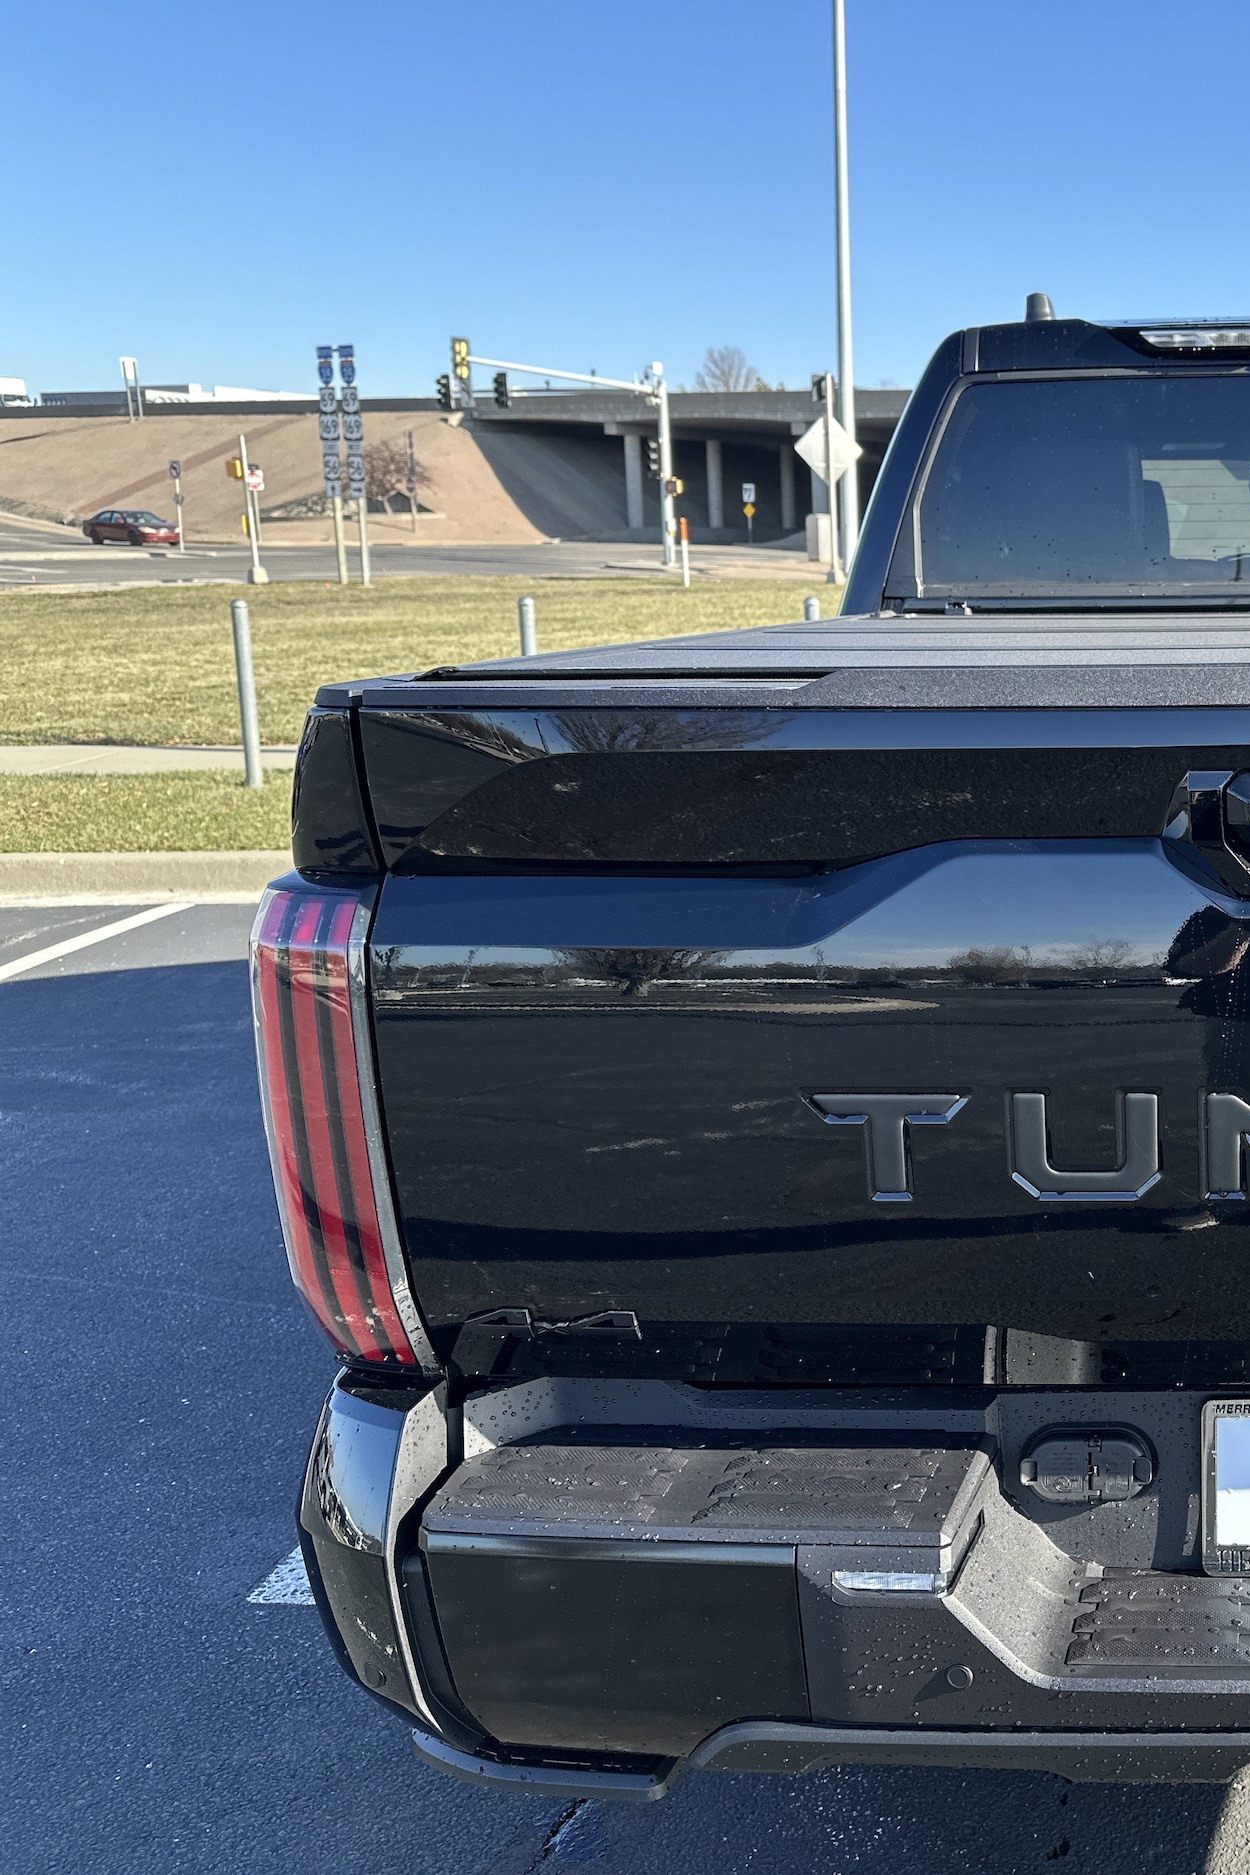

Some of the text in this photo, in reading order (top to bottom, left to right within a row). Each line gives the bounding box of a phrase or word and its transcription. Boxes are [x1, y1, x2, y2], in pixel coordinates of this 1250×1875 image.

[322, 392, 335, 408] 69
[343, 391, 357, 408] 69
[321, 419, 338, 434] 169
[344, 419, 361, 434] 169
[324, 459, 339, 475] 56
[348, 460, 363, 476] 56
